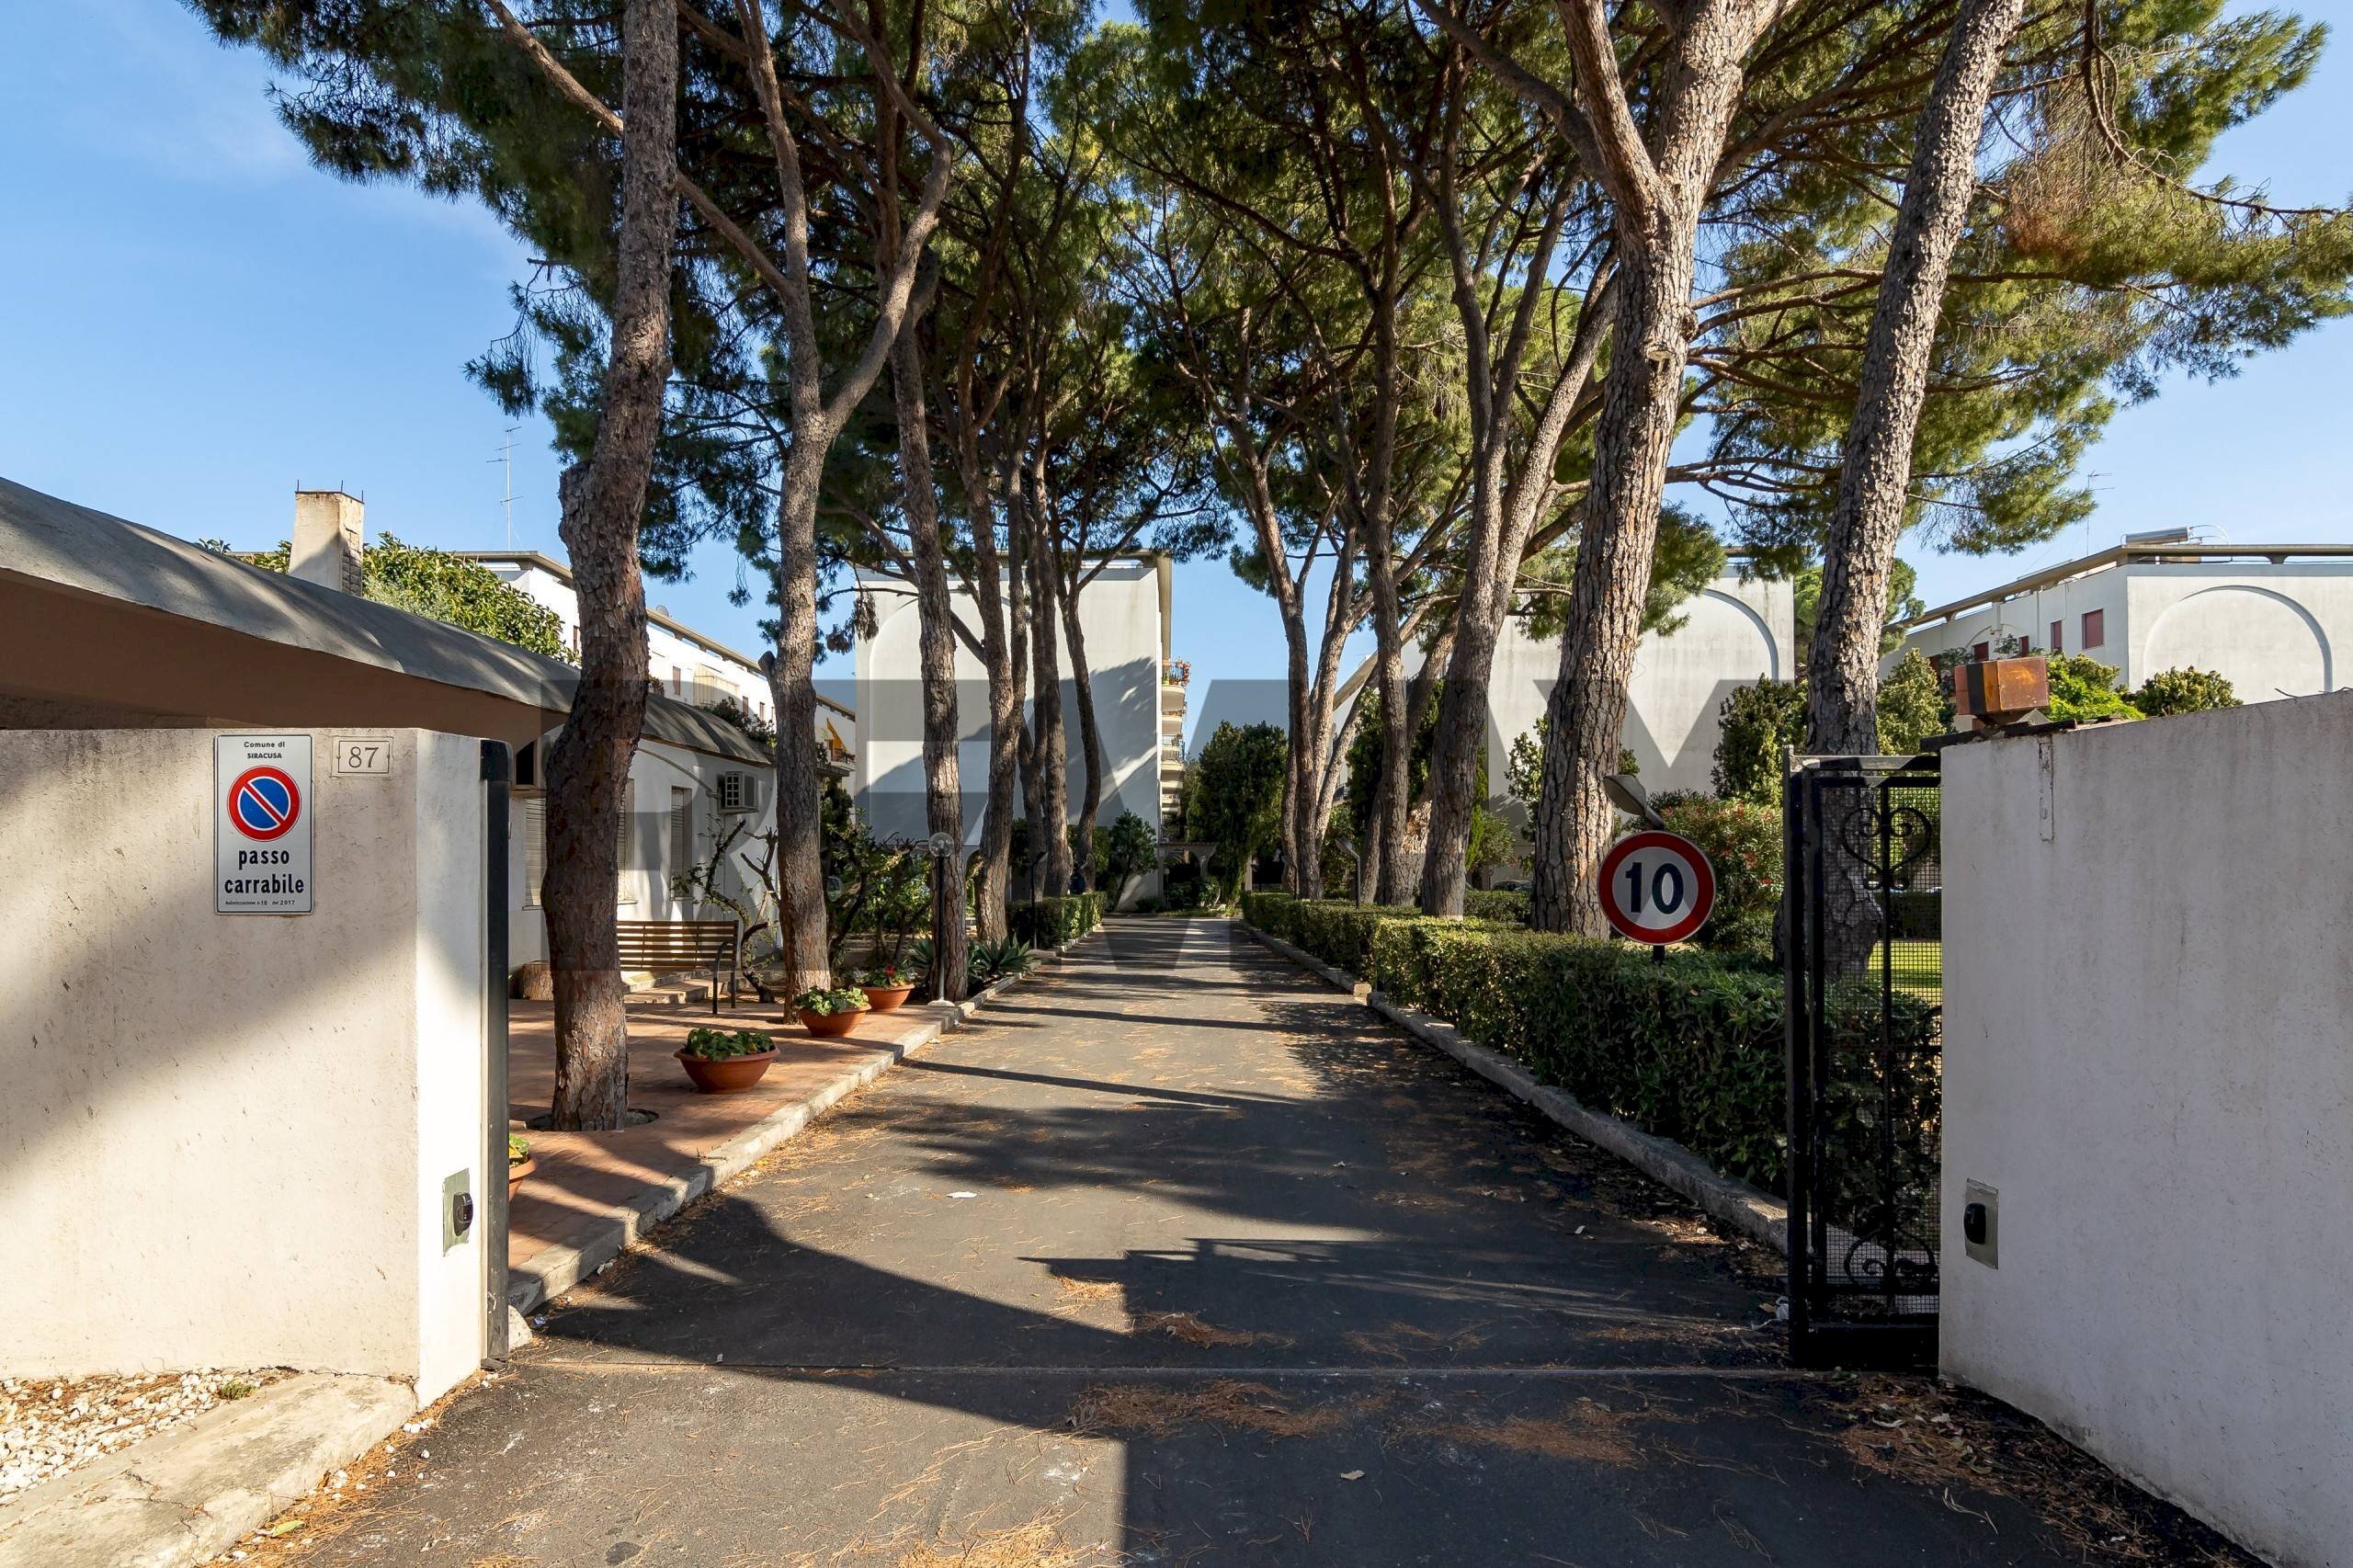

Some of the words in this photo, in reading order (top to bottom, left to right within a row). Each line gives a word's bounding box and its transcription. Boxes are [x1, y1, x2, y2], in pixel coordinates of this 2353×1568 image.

[347, 745, 380, 768] 87
[238, 848, 290, 871] passo
[223, 873, 304, 894] carrabile
[1624, 861, 1685, 915] 10
